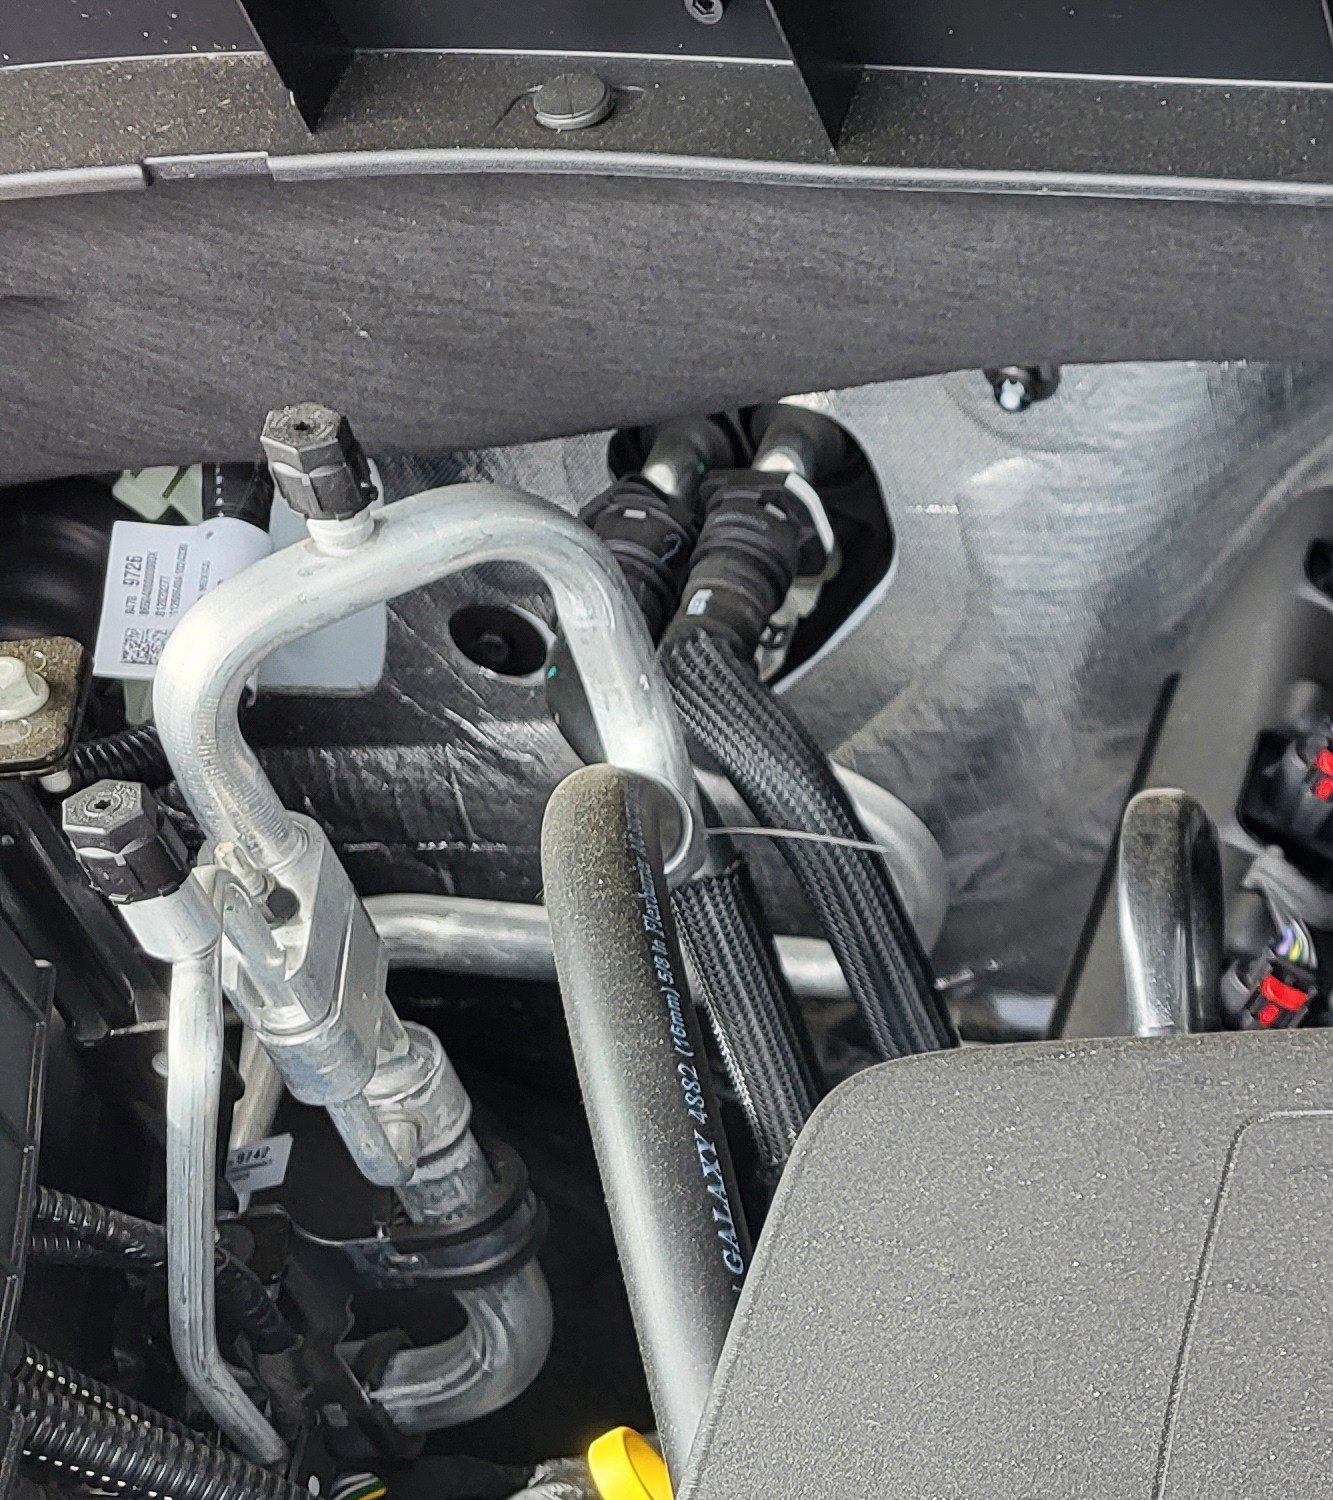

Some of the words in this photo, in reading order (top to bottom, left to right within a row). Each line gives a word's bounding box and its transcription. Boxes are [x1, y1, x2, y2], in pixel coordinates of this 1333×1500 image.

[122, 554, 143, 587] 9726
[653, 955, 675, 985] 5/8
[659, 986, 695, 1058] (16mm)
[694, 1128, 744, 1275] GALAXY
